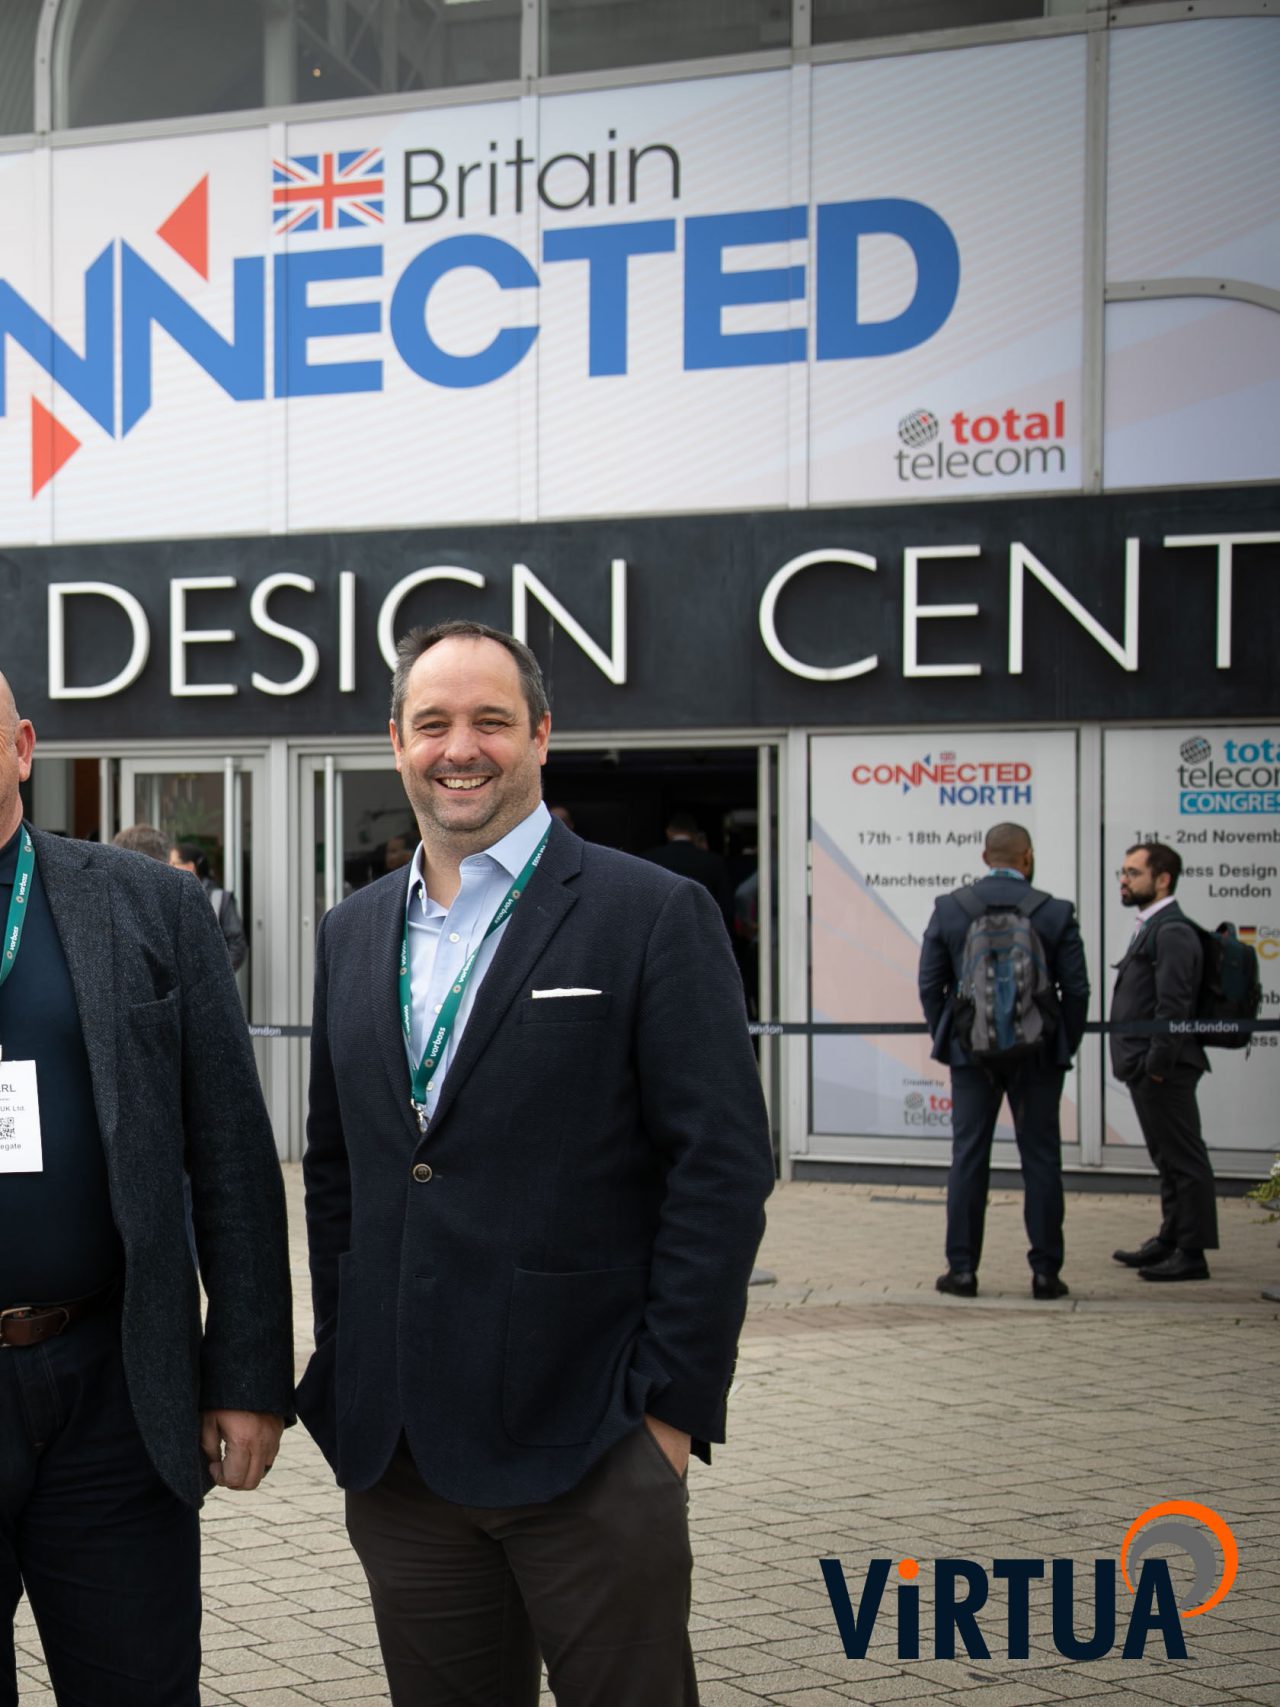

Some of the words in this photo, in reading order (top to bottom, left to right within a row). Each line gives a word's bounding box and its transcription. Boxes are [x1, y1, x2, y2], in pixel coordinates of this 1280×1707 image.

[403, 129, 680, 223] Britain
[950, 400, 1065, 446] total
[894, 441, 1066, 481] telecom
[759, 530, 1280, 681] CENT
[851, 760, 1033, 787] CONNECTED
[938, 784, 1032, 807] NORTH
[857, 831, 892, 845] 17th
[907, 830, 942, 845] 18th
[945, 830, 983, 848] April
[1176, 829, 1208, 844] 2nd
[865, 872, 956, 889] Manchester
[1218, 862, 1277, 881] Design
[1208, 883, 1272, 899] London
[1168, 1020, 1239, 1033] bdc.london
[429, 1026, 447, 1058] vorboss
[0, 1104, 11, 1112] UK
